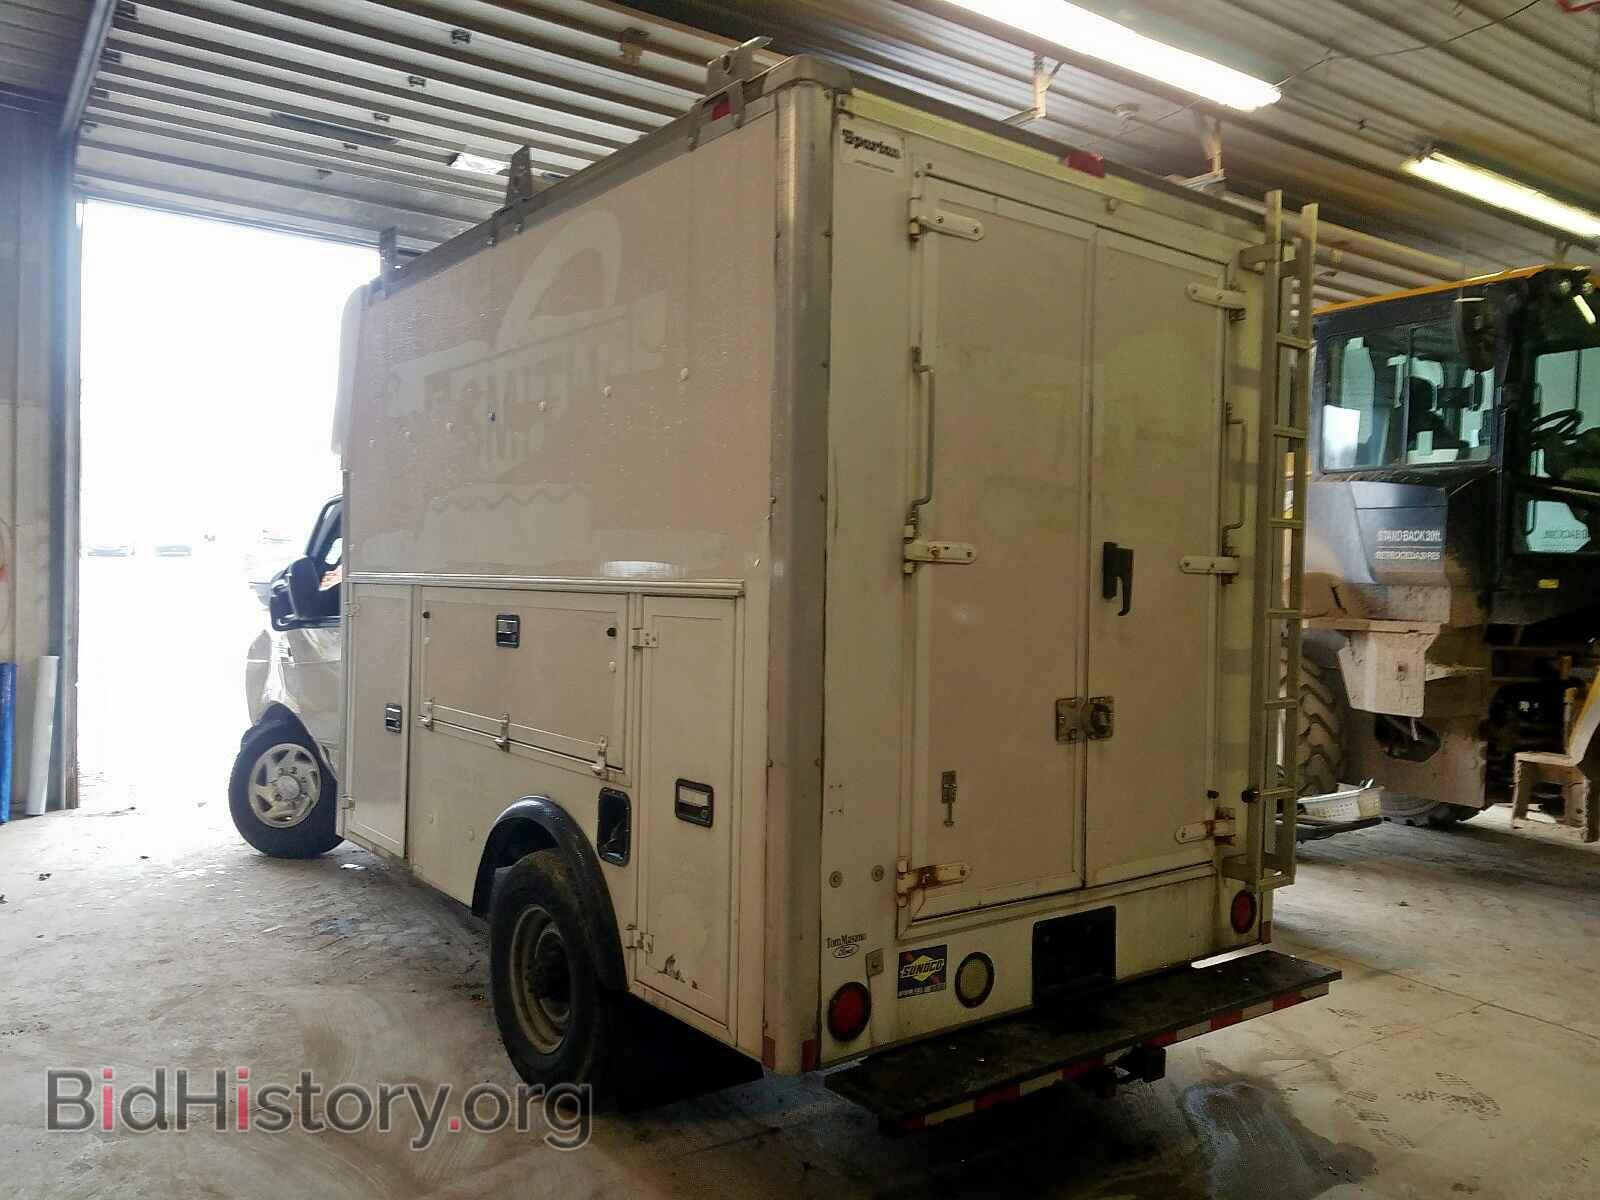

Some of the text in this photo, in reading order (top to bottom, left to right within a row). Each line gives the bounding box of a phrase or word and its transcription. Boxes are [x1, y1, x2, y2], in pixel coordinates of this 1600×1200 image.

[841, 128, 901, 159] Spartan
[1403, 529, 1425, 541] BACK
[827, 937, 841, 949] Tom
[900, 959, 945, 978] SUNOCO
